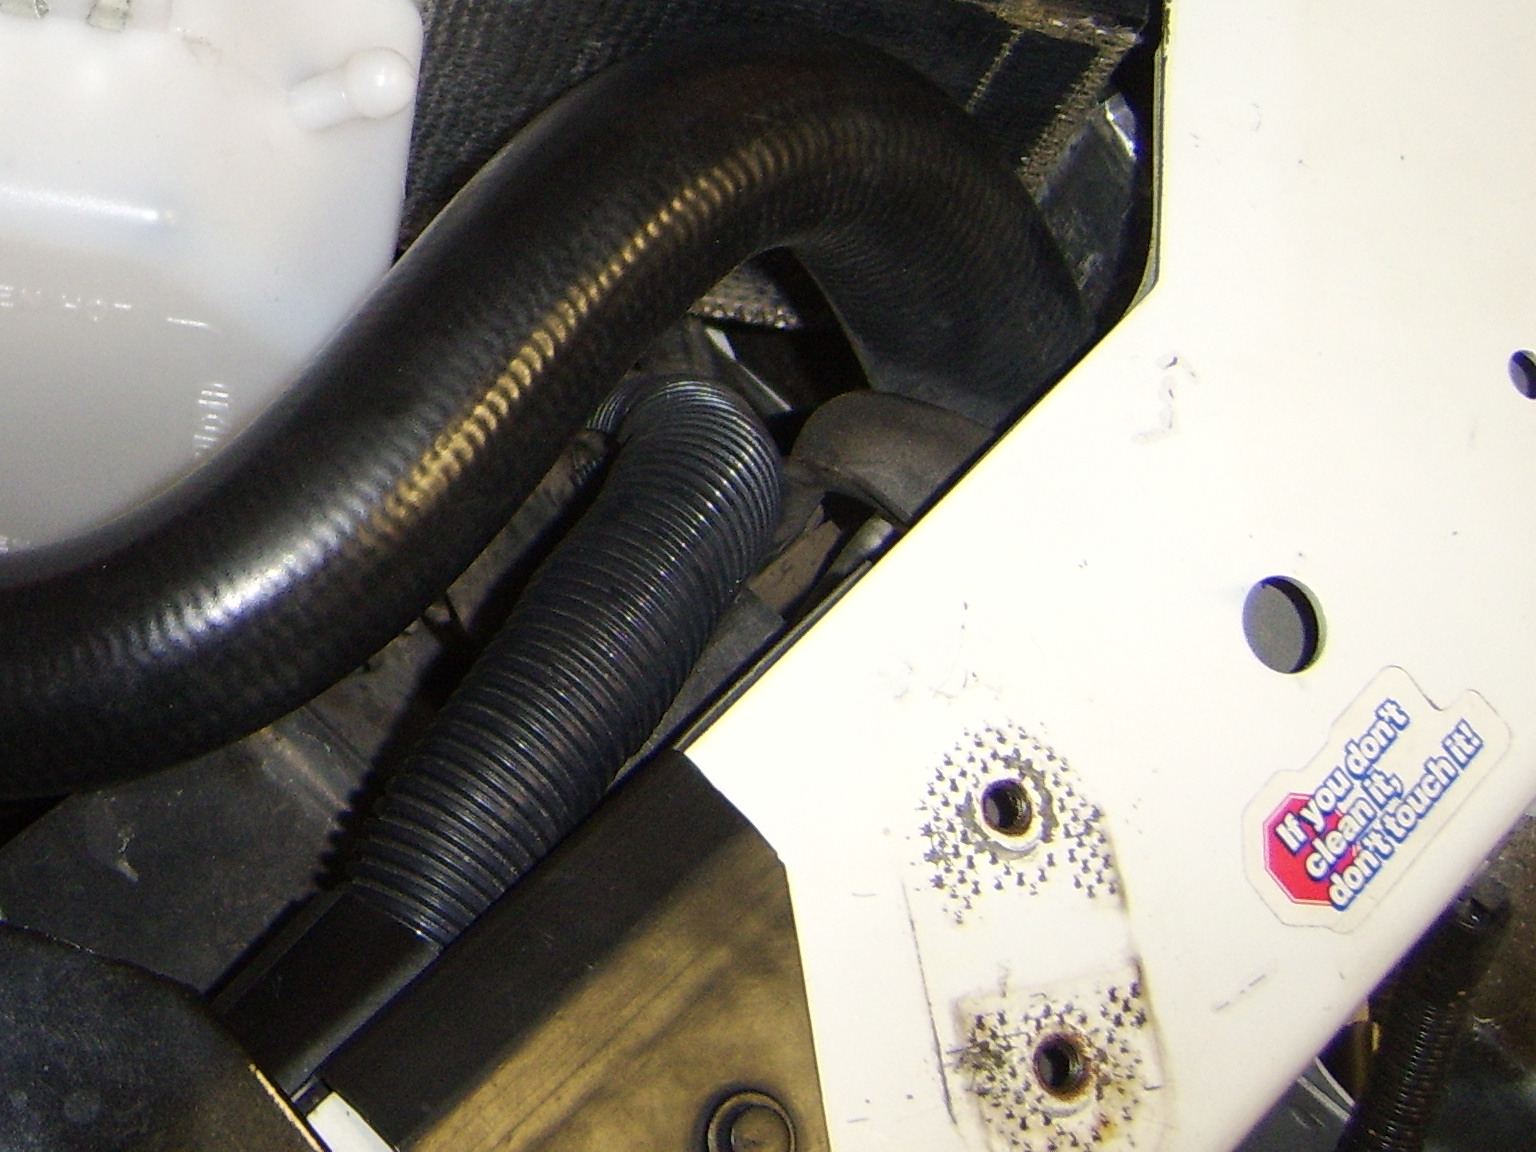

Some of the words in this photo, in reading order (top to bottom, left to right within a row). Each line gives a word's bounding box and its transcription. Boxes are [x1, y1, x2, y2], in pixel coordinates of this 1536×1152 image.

[1274, 812, 1311, 856] If
[1299, 766, 1355, 837] you
[1304, 796, 1377, 881] clean
[1360, 765, 1405, 810] it,
[1379, 755, 1460, 845] touch
[1440, 717, 1484, 771] it!
